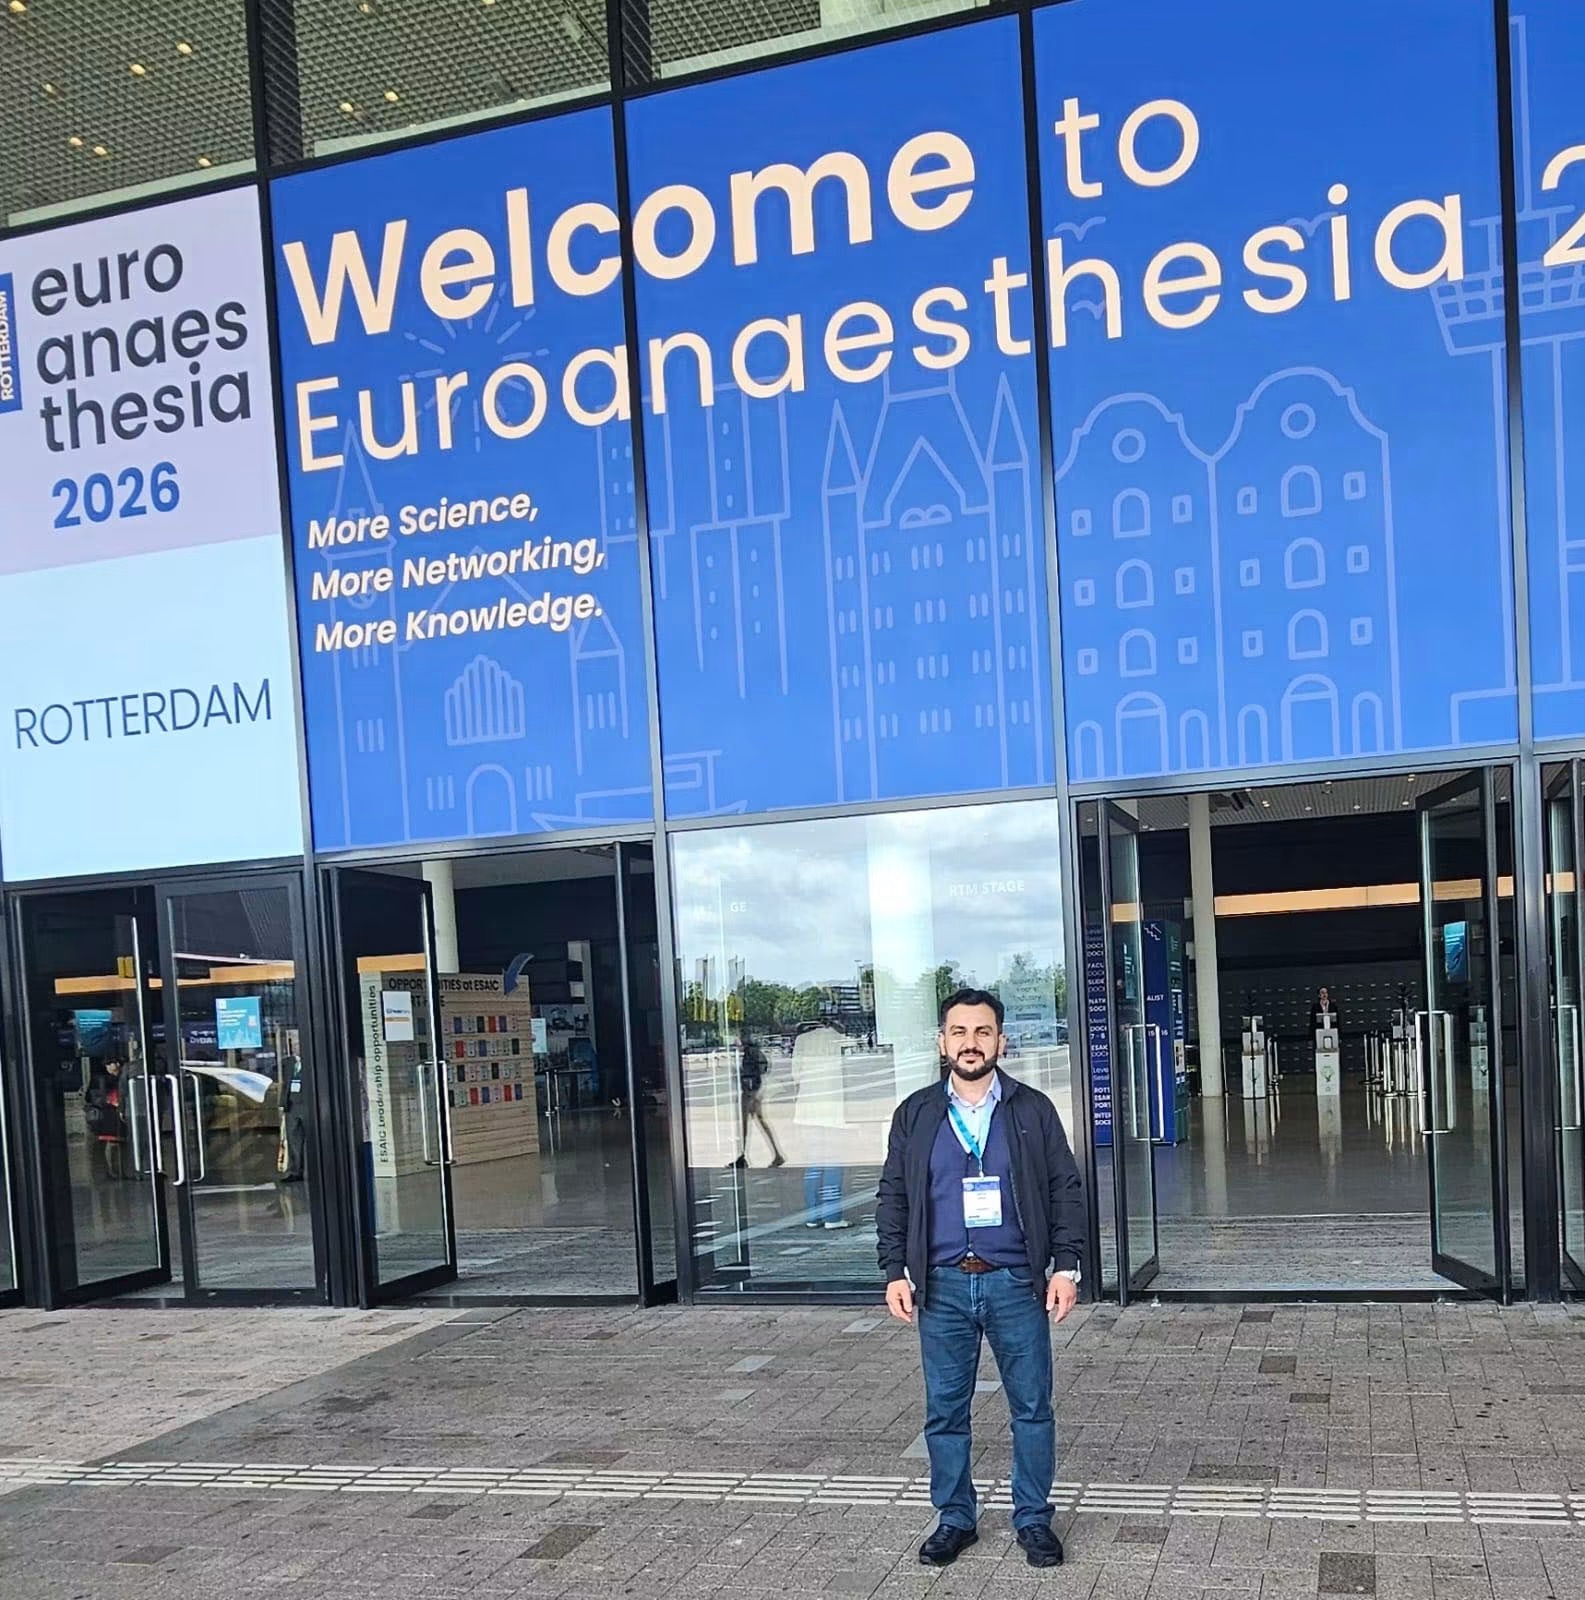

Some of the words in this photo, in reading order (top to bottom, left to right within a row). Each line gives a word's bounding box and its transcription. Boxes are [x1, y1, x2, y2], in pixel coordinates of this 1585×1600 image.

[282, 130, 976, 347] Welcome
[1055, 97, 1200, 199] to
[31, 243, 184, 316] euro
[37, 301, 248, 384] anaes
[295, 183, 1464, 473] Euroanaesthesia
[40, 361, 251, 453] thesia
[51, 461, 180, 529] 2026
[308, 514, 390, 549] More
[399, 492, 538, 535] Science,
[312, 566, 393, 600] More
[402, 536, 605, 589] Networking,
[315, 618, 397, 653] More
[405, 592, 602, 641] Knowledge.
[14, 678, 272, 749] ROTTERDAM
[949, 883, 978, 897] RTM
[981, 879, 1025, 894] STAGE
[474, 979, 499, 992] ESAIC
[378, 1130, 389, 1163] ESAIC
